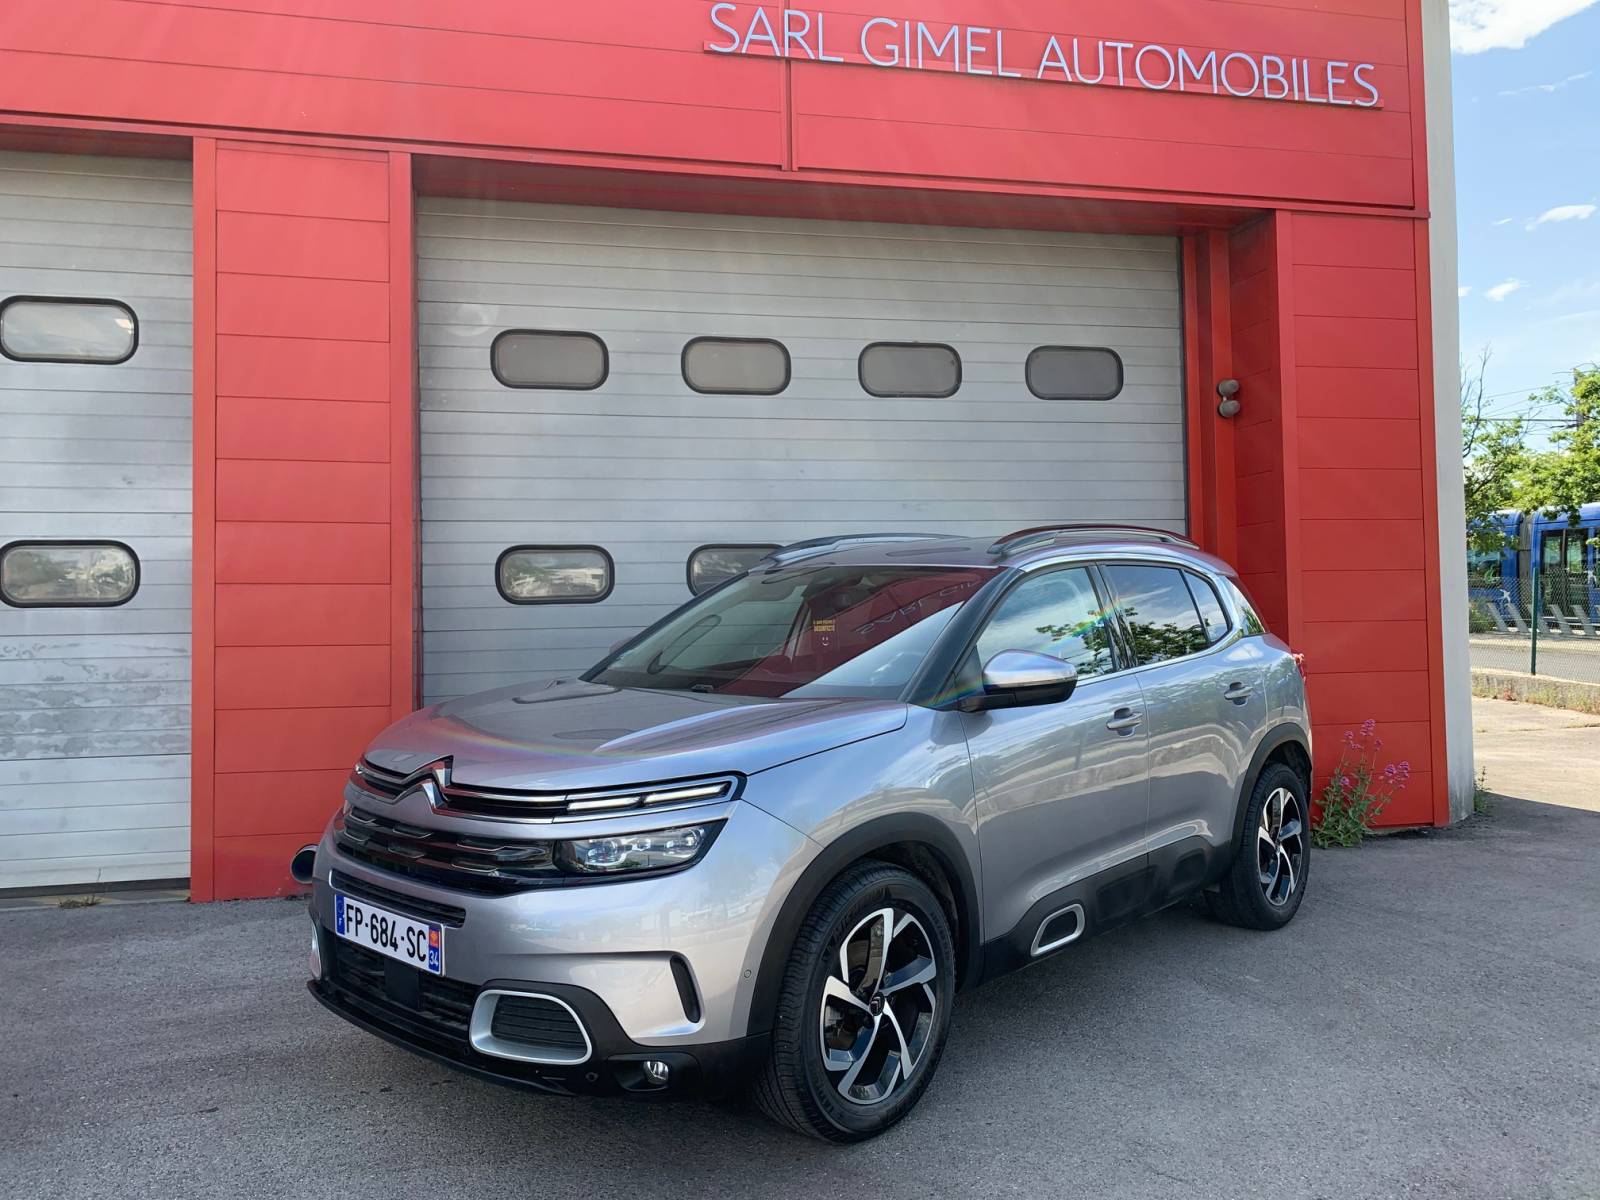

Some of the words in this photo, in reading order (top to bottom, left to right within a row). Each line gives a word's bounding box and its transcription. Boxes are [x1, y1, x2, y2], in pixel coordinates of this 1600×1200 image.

[709, 2, 844, 63] SARL
[860, 17, 1022, 78] GIMEL
[1036, 35, 1380, 107] AUTOMOBILES
[346, 903, 426, 962] FP-684-SC
[429, 950, 439, 967] 34
